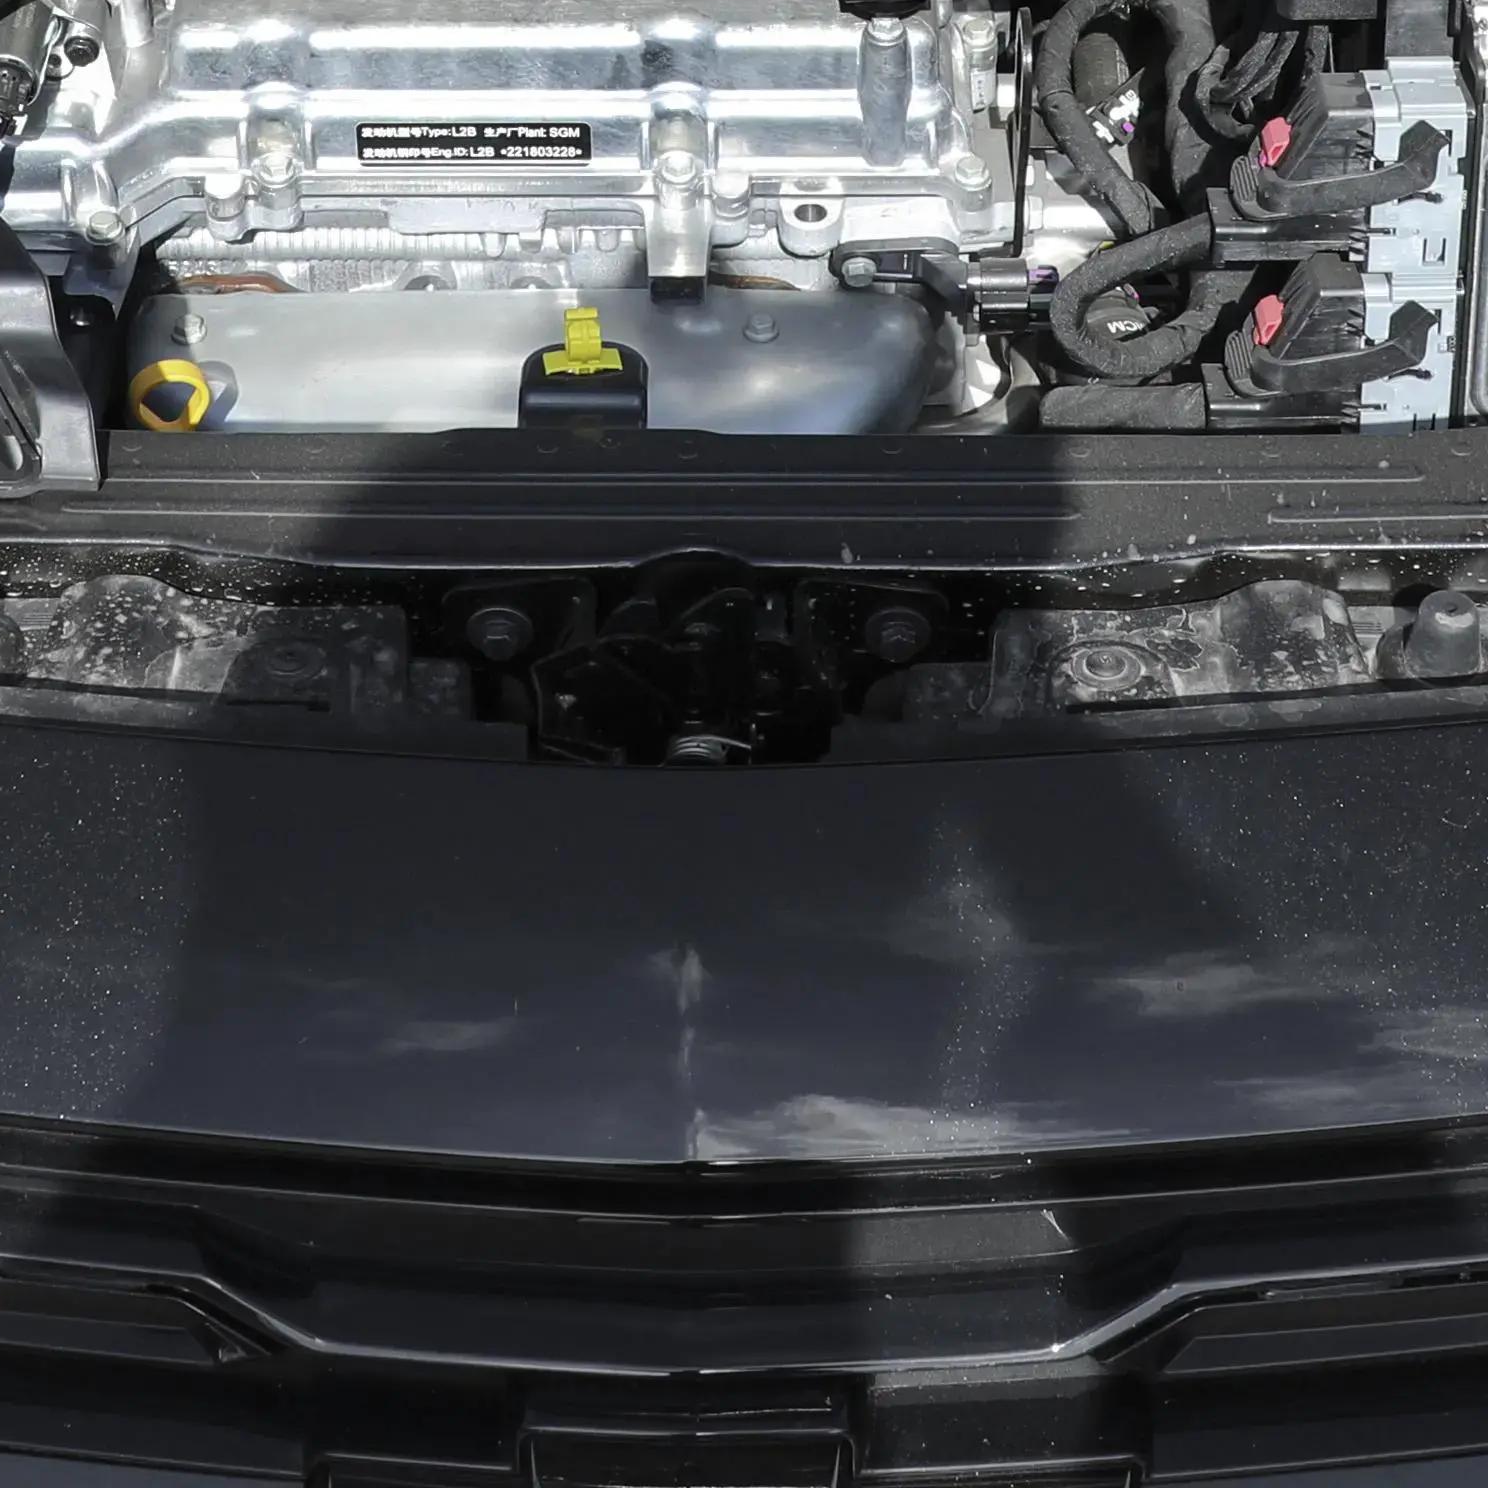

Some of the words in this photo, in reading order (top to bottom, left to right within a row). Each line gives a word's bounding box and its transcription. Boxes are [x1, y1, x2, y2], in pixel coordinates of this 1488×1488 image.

[452, 127, 477, 138] L2B
[549, 127, 581, 138] SGM
[470, 147, 495, 158] L2B
